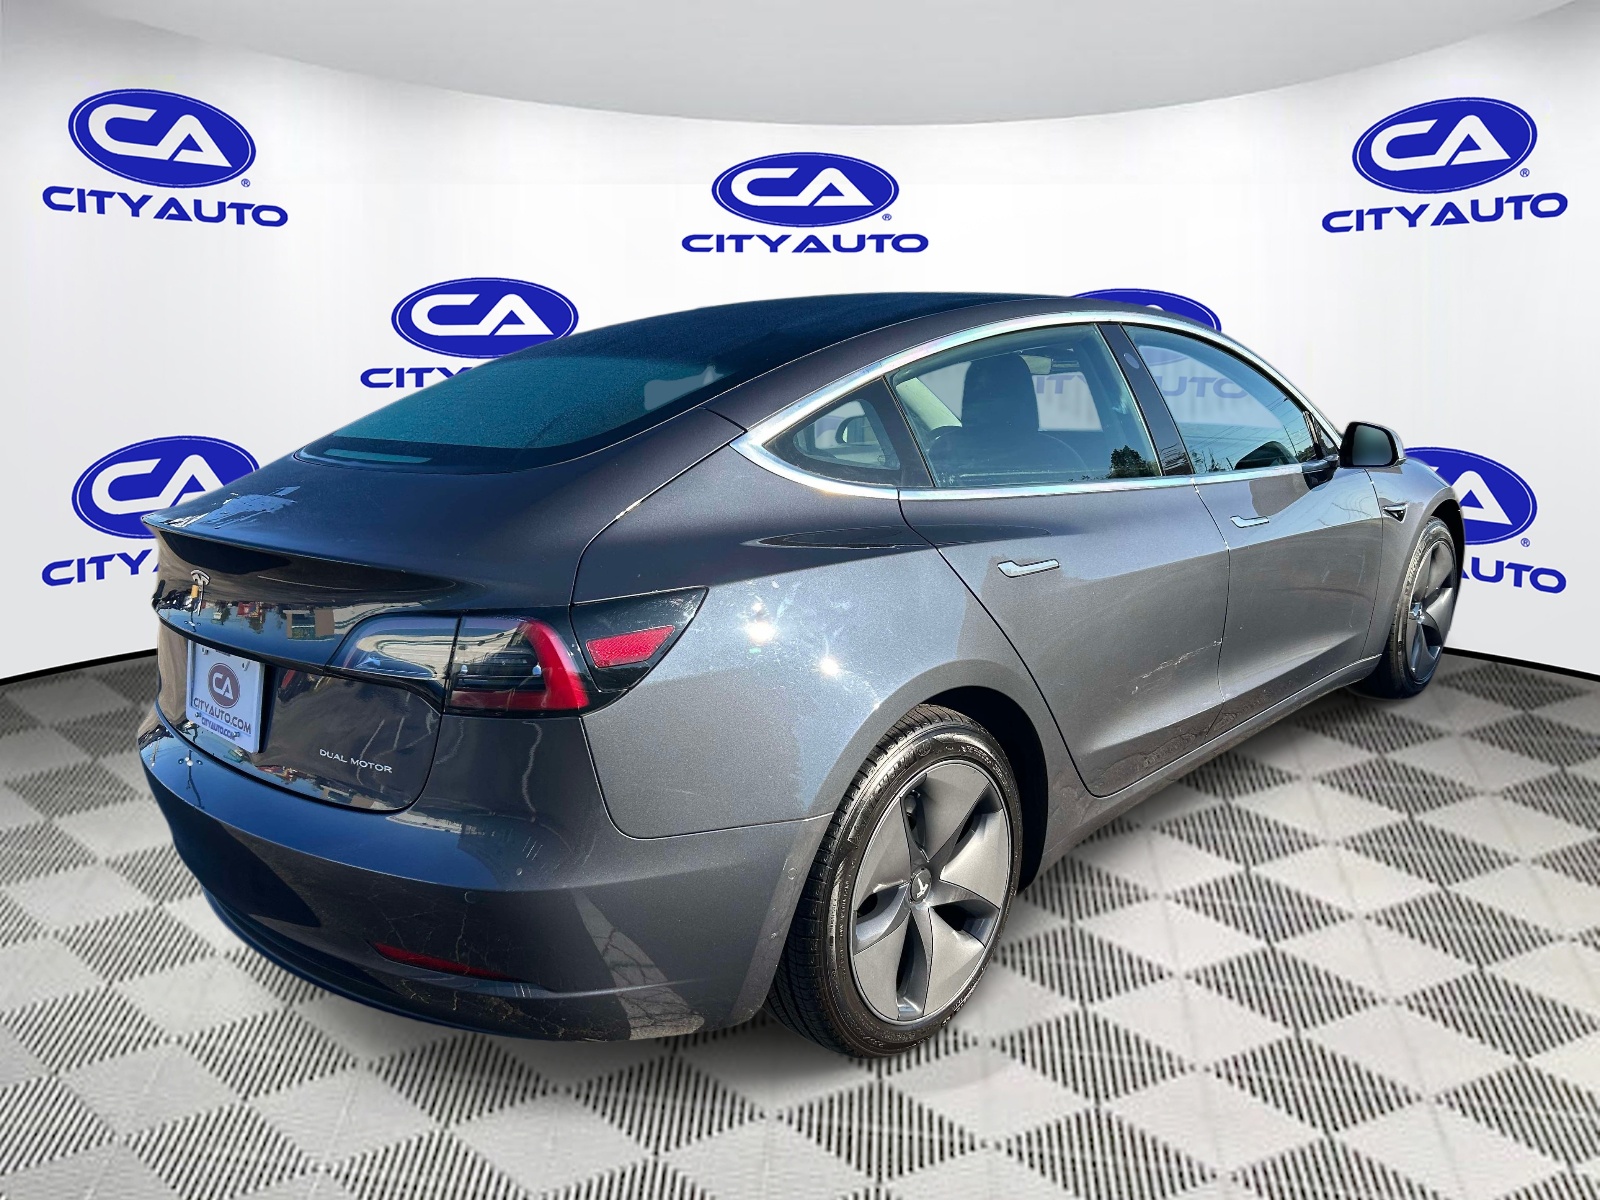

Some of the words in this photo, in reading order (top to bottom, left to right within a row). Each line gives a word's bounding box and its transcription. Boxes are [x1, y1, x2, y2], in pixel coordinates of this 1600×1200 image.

[89, 104, 232, 168] CA
[1371, 115, 1511, 172] CA
[731, 167, 874, 207] CA
[411, 293, 554, 337] CA
[92, 454, 224, 515] CA
[212, 672, 234, 700] CA
[319, 748, 348, 763] DUAL
[350, 757, 393, 774] MOTOR
